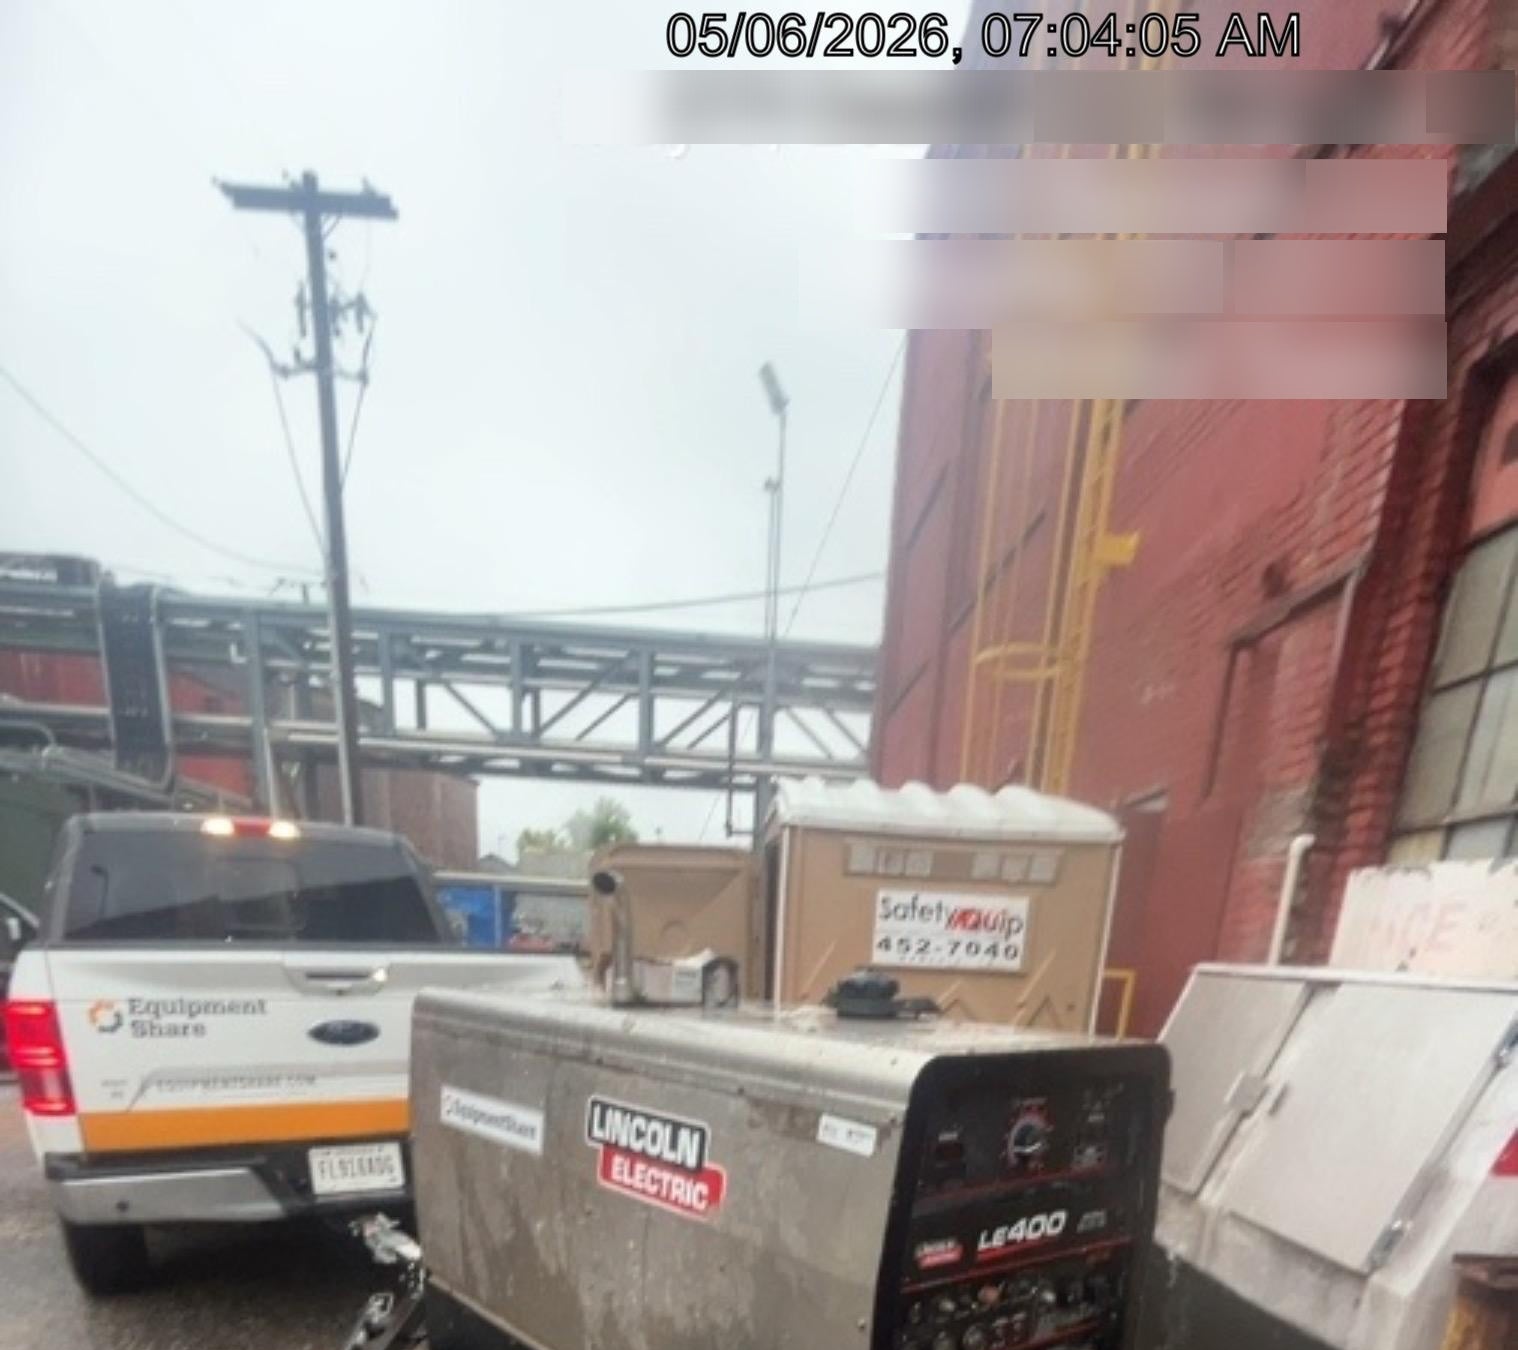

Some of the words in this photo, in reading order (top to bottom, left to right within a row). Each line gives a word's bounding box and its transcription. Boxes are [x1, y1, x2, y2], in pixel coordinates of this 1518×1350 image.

[875, 937, 1019, 961] 452-7040
[128, 997, 268, 1019] Equipment
[130, 1019, 207, 1038] Share
[591, 1110, 702, 1169] LINCOLN
[610, 1156, 710, 1210] ELECTRIC
[976, 1210, 1068, 1251] LE400
